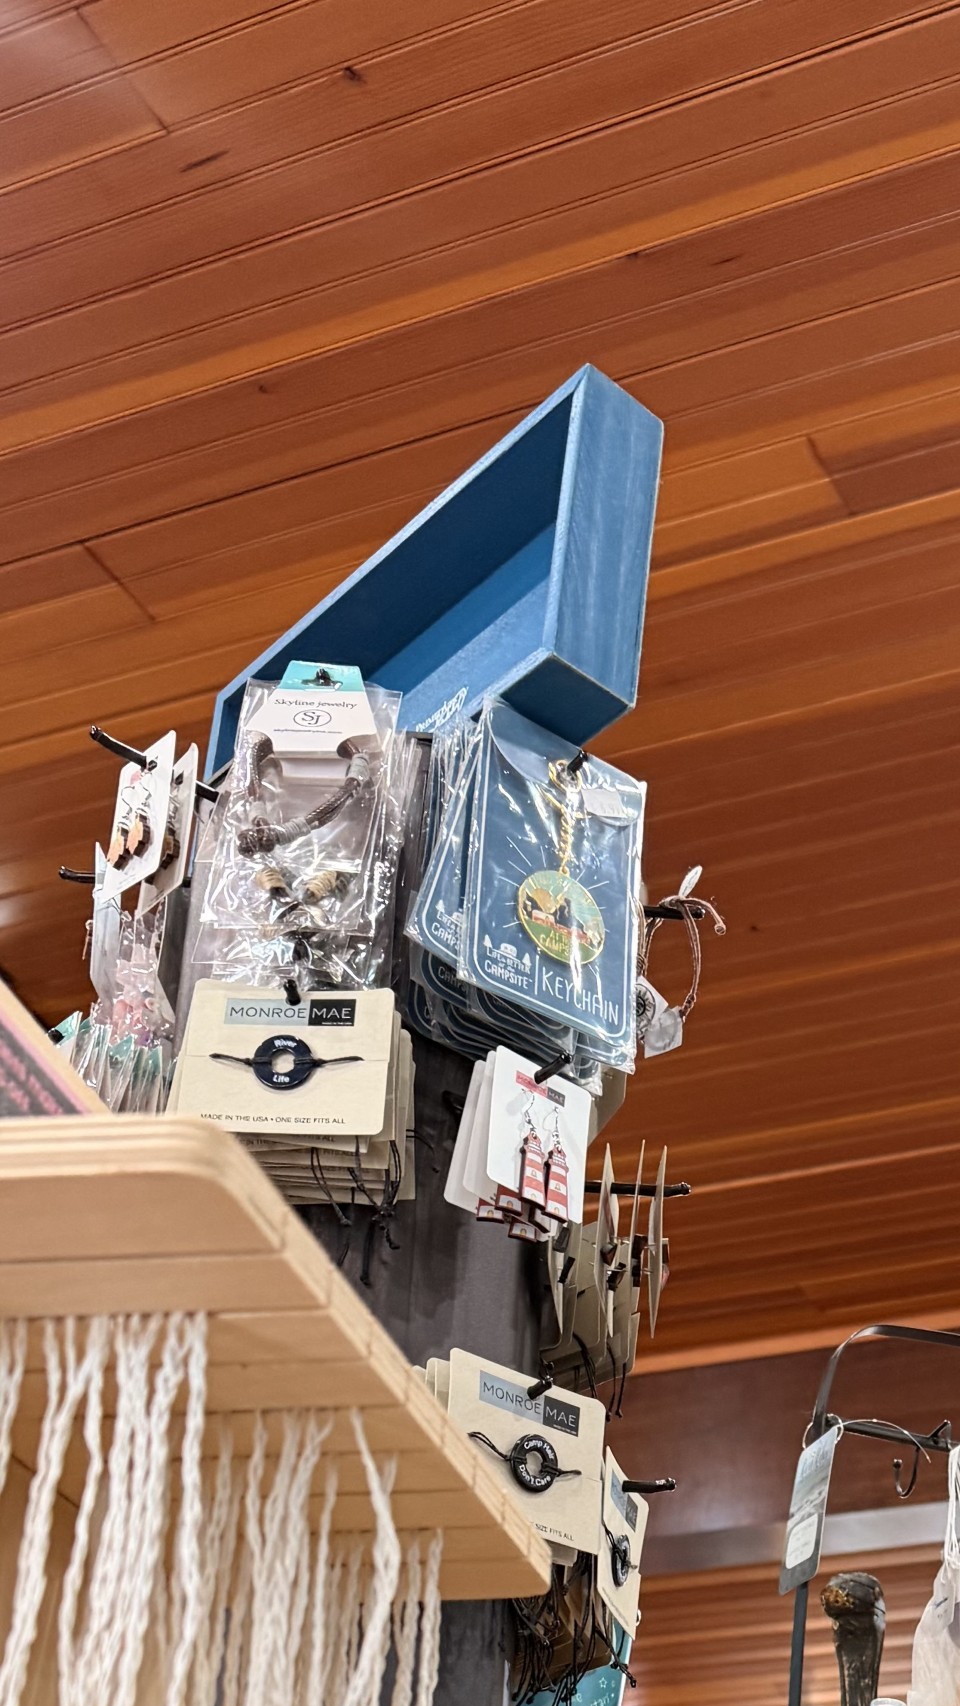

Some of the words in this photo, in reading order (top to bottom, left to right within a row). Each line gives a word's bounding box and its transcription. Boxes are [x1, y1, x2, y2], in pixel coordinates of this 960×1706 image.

[274, 698, 315, 709] Skyline
[316, 699, 357, 710] jewelry
[300, 711, 321, 726] SJ
[484, 959, 530, 989] CAMPSITE
[542, 966, 620, 1026] KEYCHAIN
[229, 1006, 308, 1019] MONROE
[312, 1007, 352, 1019] MAE
[273, 1038, 298, 1049] River
[200, 1113, 223, 1121] MADE
[294, 1116, 312, 1124] SIZE
[313, 1117, 330, 1125] FITS
[332, 1117, 346, 1125] ALL
[482, 1381, 542, 1415] MONROE
[545, 1406, 576, 1427] MAE
[523, 1438, 543, 1450] Camp
[535, 1475, 552, 1487] Care
